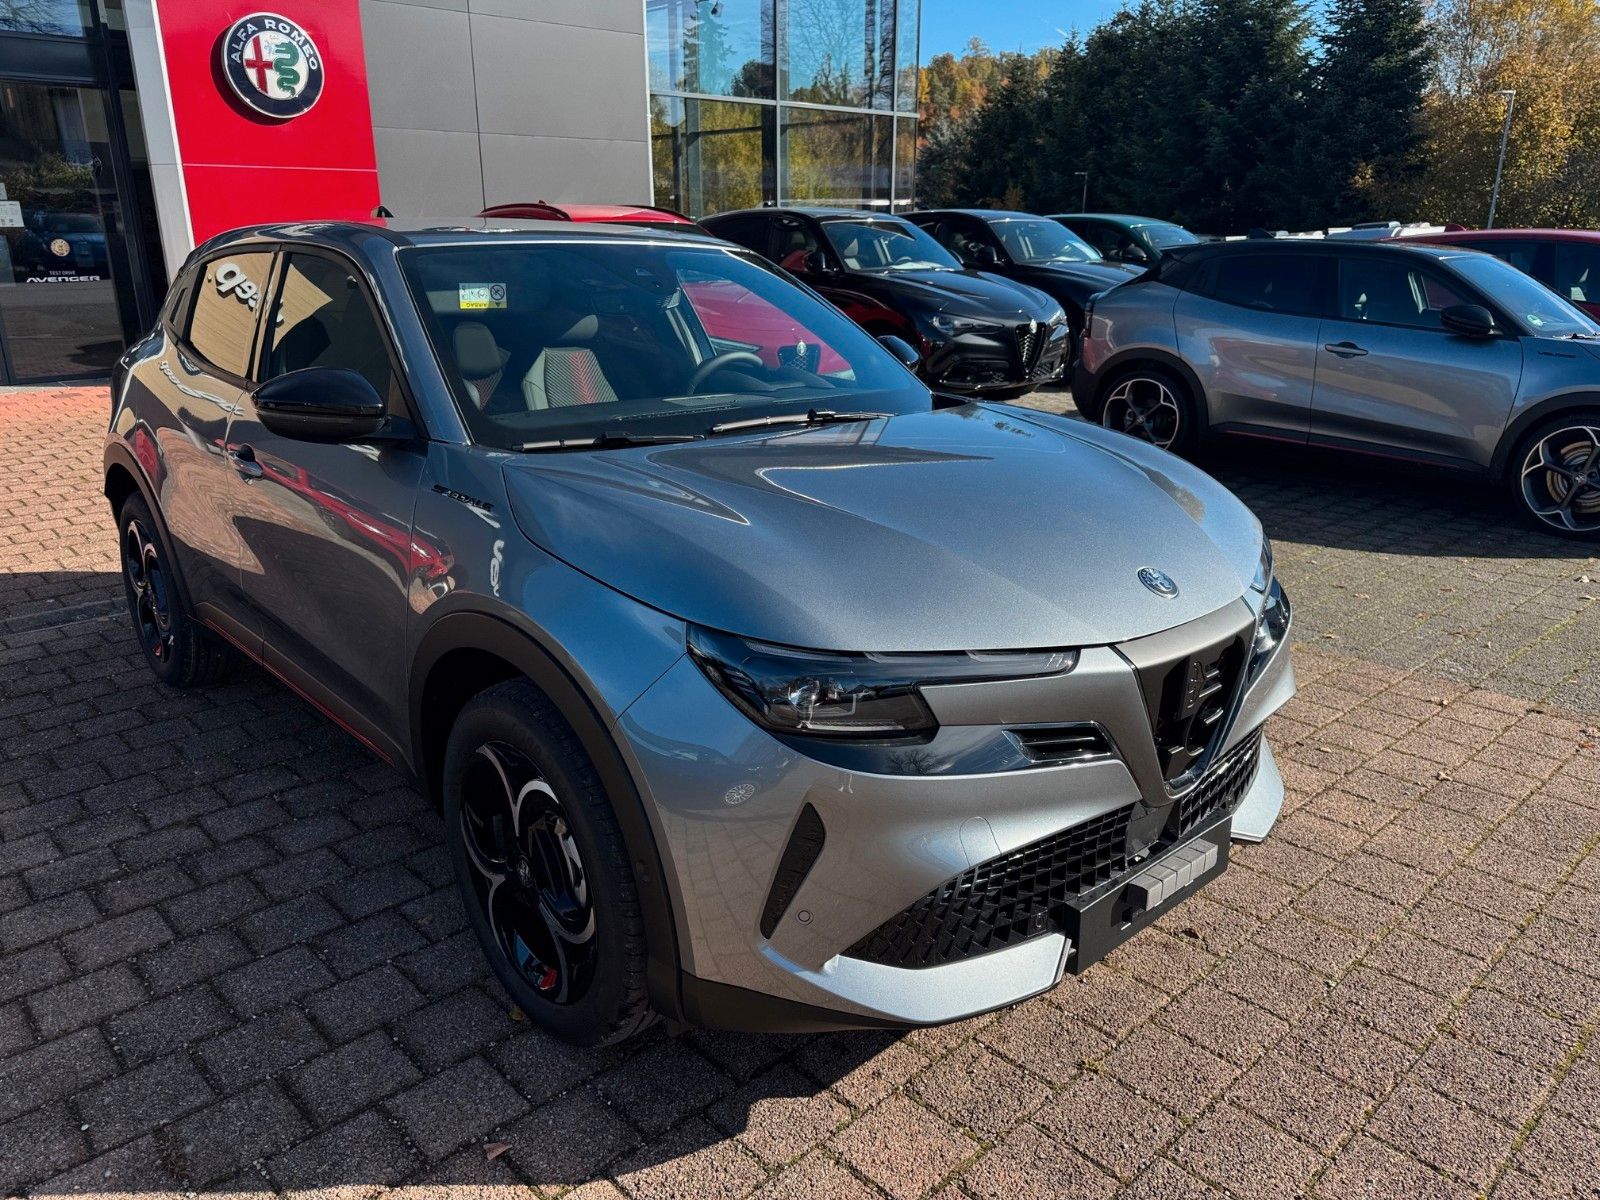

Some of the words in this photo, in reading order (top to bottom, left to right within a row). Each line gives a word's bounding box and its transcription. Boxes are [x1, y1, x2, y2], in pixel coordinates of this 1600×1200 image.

[230, 23, 258, 64] ALFA
[264, 19, 318, 70] ROMEO
[26, 275, 100, 283] AVENGER
